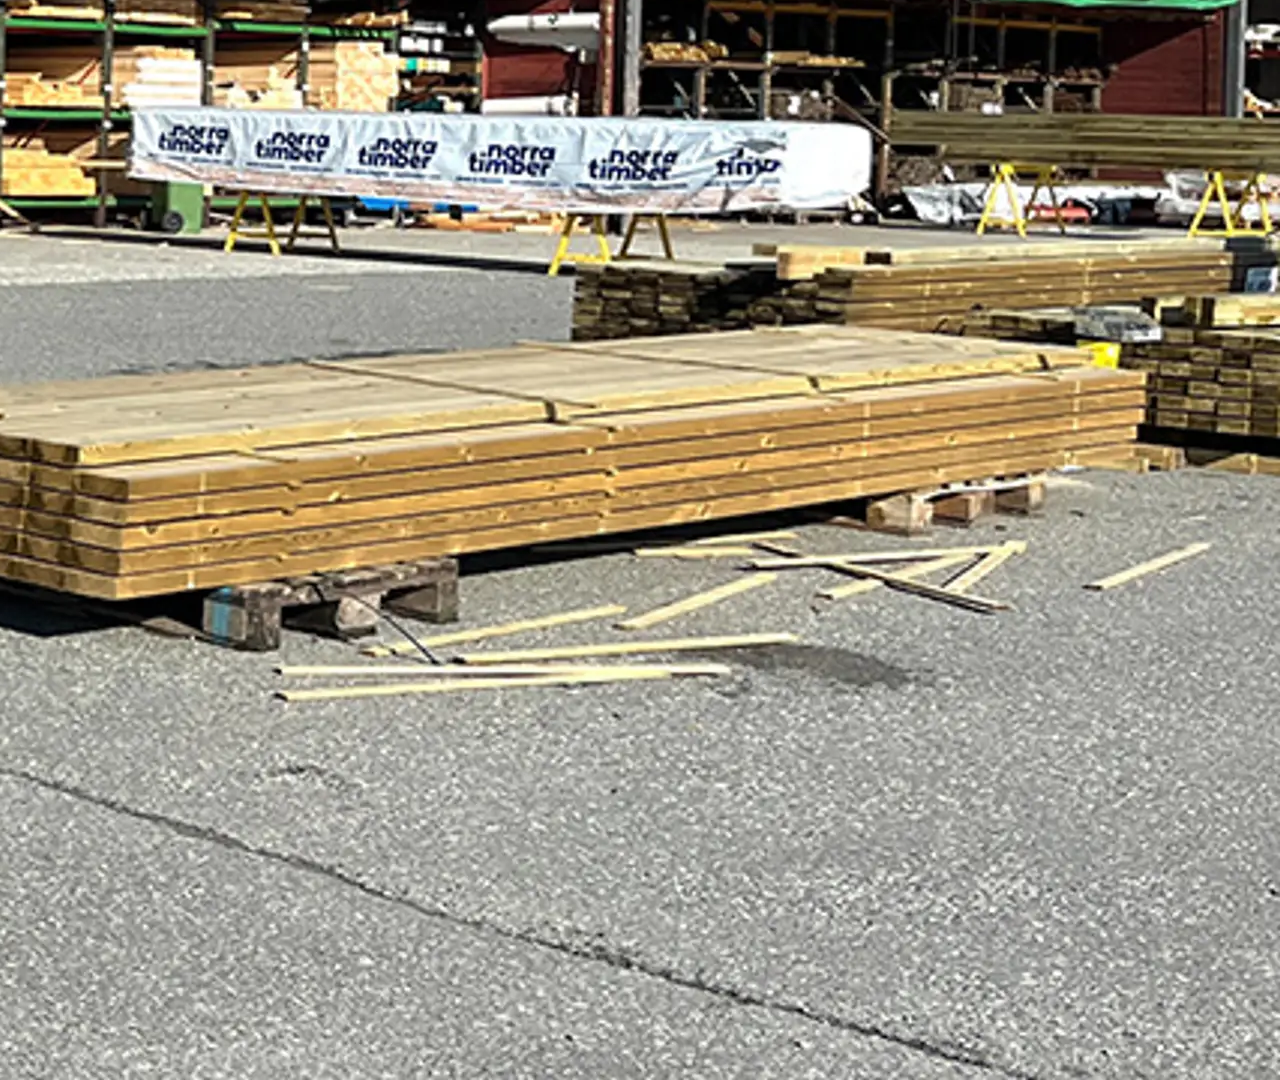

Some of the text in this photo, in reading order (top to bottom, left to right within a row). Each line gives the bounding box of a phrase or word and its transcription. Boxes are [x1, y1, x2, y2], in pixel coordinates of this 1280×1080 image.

[170, 124, 229, 142] norra
[271, 131, 330, 149] norra
[158, 132, 226, 155] timber
[256, 138, 327, 163] timber
[376, 137, 438, 154] norra
[488, 143, 556, 161] norra
[358, 146, 433, 170] timber
[469, 151, 552, 177] timber
